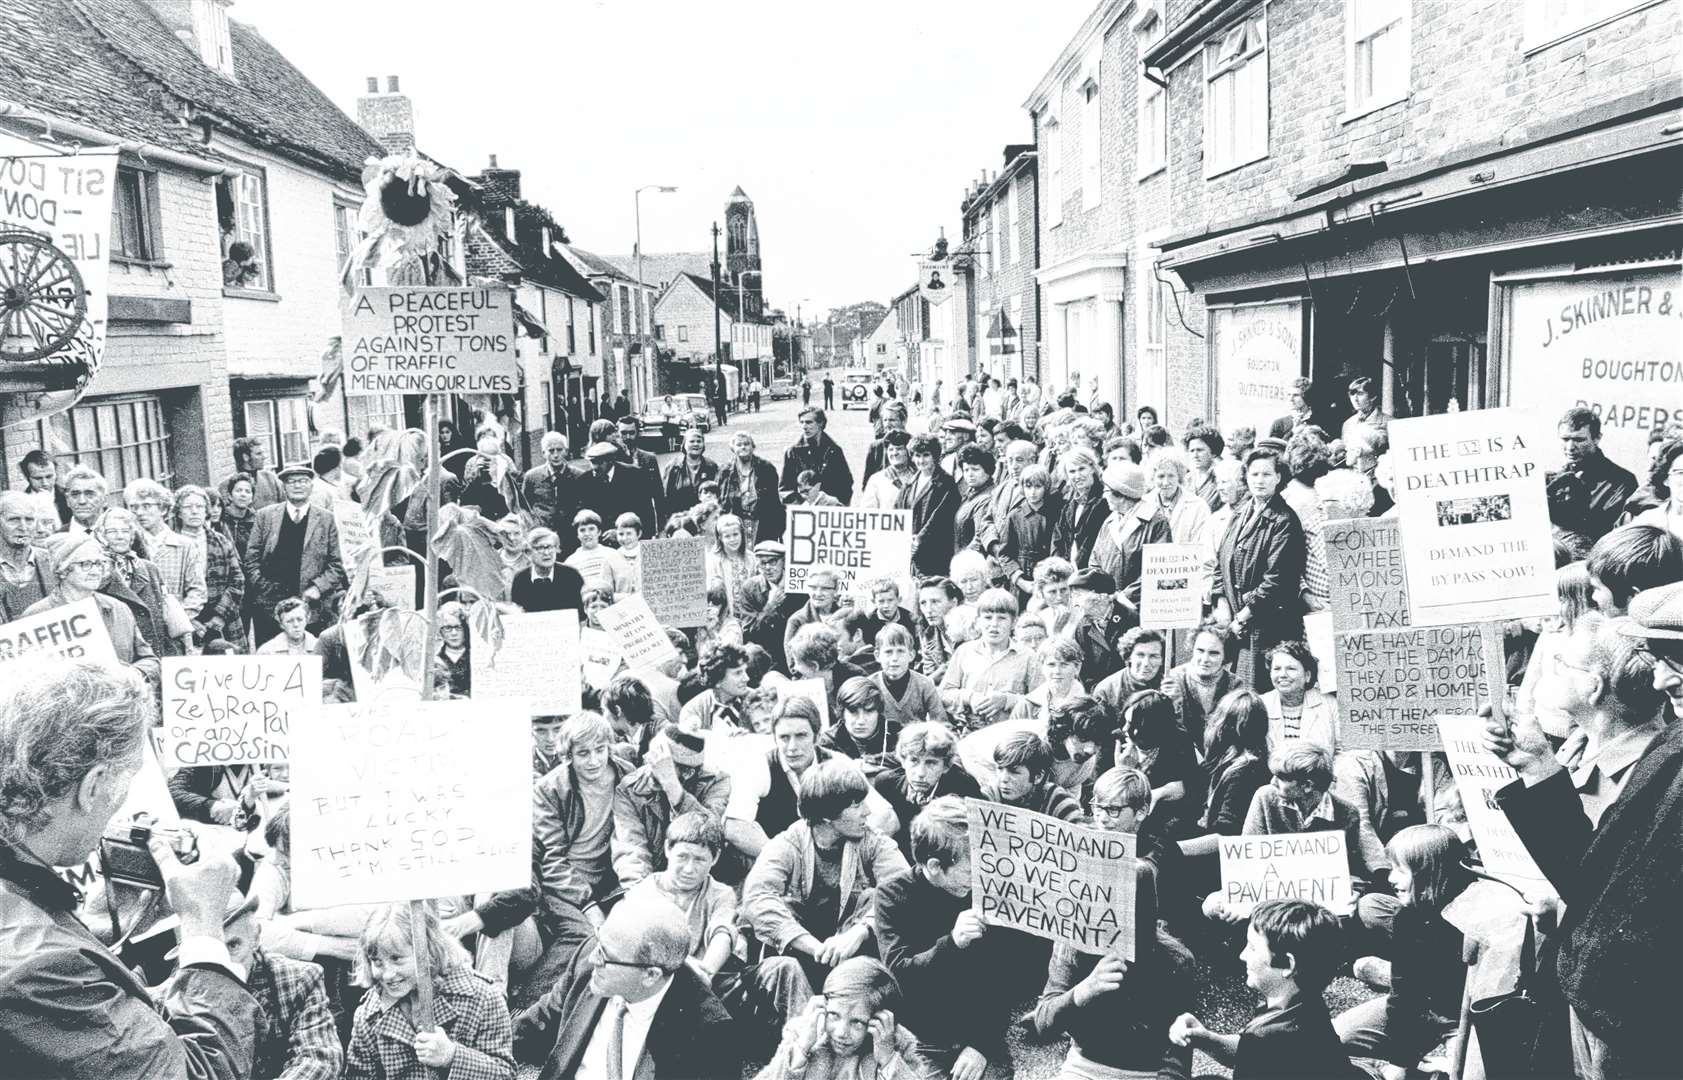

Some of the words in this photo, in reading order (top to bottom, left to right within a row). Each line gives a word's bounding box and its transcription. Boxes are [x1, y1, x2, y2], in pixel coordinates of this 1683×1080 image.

[354, 295, 376, 316] A
[389, 290, 499, 313] PEACEFUL
[1560, 286, 1652, 334] SKINNER
[1658, 291, 1673, 316] &
[394, 315, 479, 335] PROTEST
[354, 335, 446, 354] AGAINST
[454, 335, 507, 352] TONS
[351, 355, 378, 372] OF
[384, 355, 457, 372] TRAFFIC
[351, 374, 433, 391] MENACING
[435, 375, 465, 390] OUR
[469, 375, 512, 391] LIVES
[1408, 444, 1450, 462] THE
[1487, 437, 1504, 452] IS
[1512, 434, 1526, 450] A
[1406, 462, 1536, 490] DEATHTRAP
[1429, 544, 1494, 561] DEMAND
[1501, 540, 1529, 554] THE
[1146, 566, 1201, 576] DEATHTRAP
[1431, 574, 1450, 586] BY
[1453, 570, 1486, 585] PASS
[1492, 566, 1536, 580] NOW!
[1350, 592, 1387, 611] PAY
[1342, 634, 1374, 650] WE
[1382, 630, 1425, 648] HAVE
[1431, 628, 1455, 645] TO
[1344, 652, 1378, 668] FOR
[1384, 650, 1419, 666] THE
[174, 667, 232, 693] Give
[282, 662, 304, 697] A
[1344, 669, 1386, 686] THEY
[1395, 668, 1421, 682] DO
[1428, 666, 1450, 680] TO
[1351, 686, 1400, 702] ROAD
[1406, 684, 1418, 698] &
[1426, 682, 1488, 698] HOMES
[1350, 708, 1382, 722] BAN
[171, 726, 196, 738] or
[204, 722, 248, 746] any
[1360, 724, 1386, 734] THE
[1454, 740, 1480, 754] THE
[312, 794, 362, 816] BUT
[366, 807, 454, 828] LUCKY
[979, 808, 1017, 834] WE
[1030, 818, 1125, 860] DEMAND
[980, 830, 998, 852] A
[1008, 836, 1078, 872] ROAD
[1224, 842, 1253, 860] WE
[1260, 835, 1340, 860] DEMAND
[980, 853, 1015, 878] SO
[1024, 864, 1062, 893] WE
[1068, 879, 1112, 904] CAN
[1264, 862, 1280, 879] A
[1228, 876, 1341, 904] PAVEMENT
[980, 874, 1047, 910] WALK
[1056, 898, 1092, 925] ON
[1096, 908, 1118, 928] A
[982, 895, 1122, 948] PAVEMENT!
